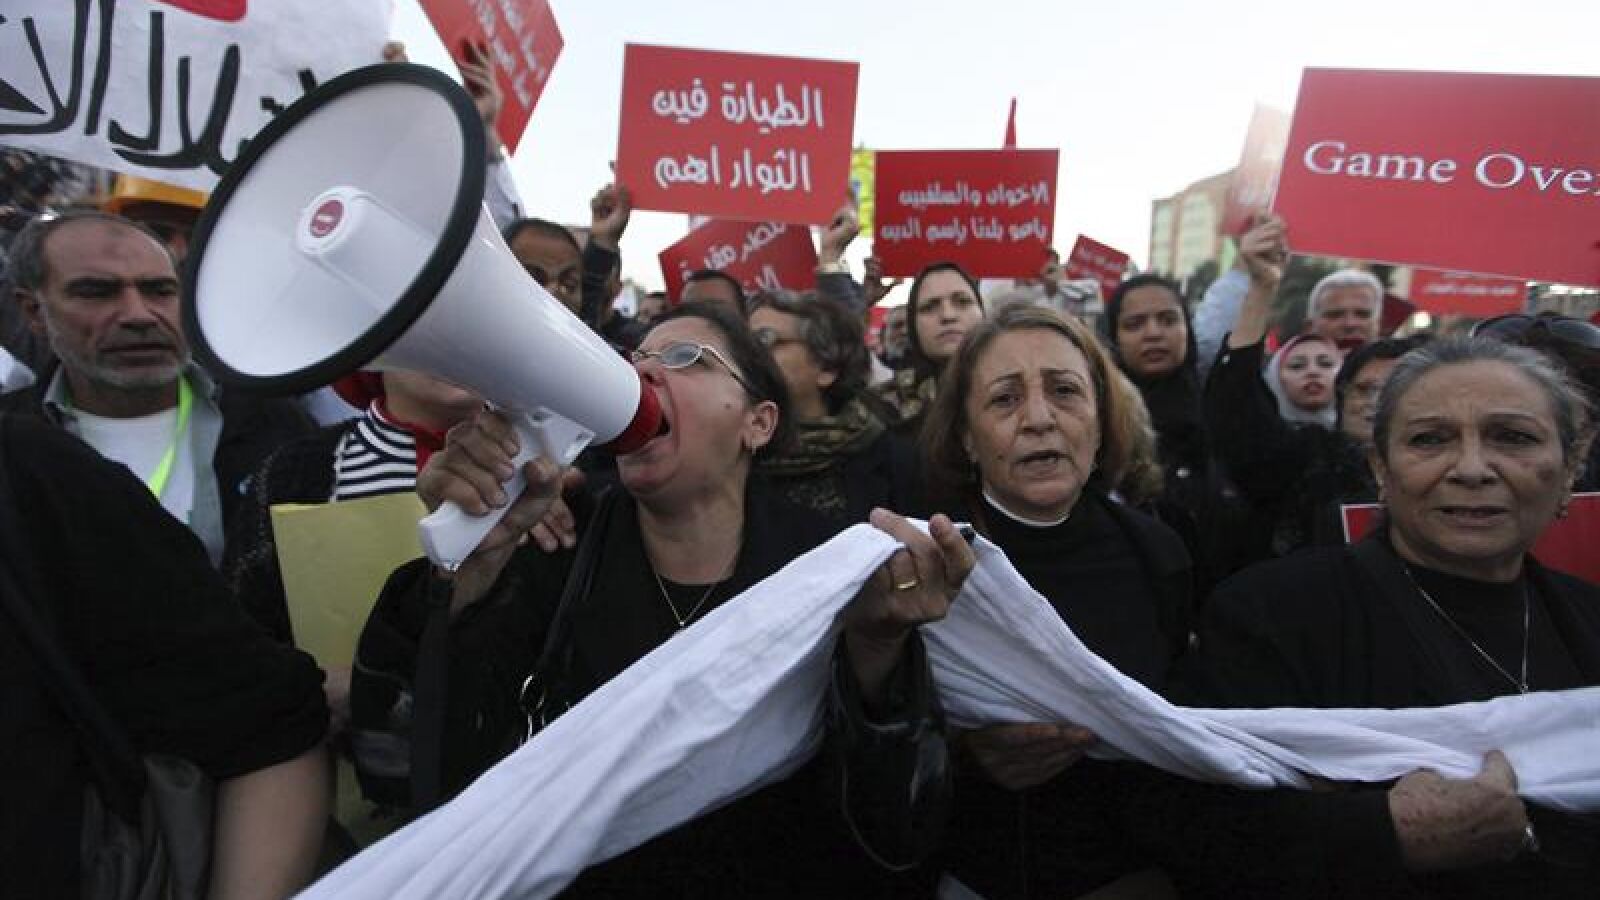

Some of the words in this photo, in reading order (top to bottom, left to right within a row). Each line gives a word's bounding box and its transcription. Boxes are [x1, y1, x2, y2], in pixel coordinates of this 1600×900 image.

[652, 76, 709, 125] فين
[720, 80, 824, 135] الطيارة
[729, 148, 811, 194] الثوار
[1303, 140, 1457, 184] Game
